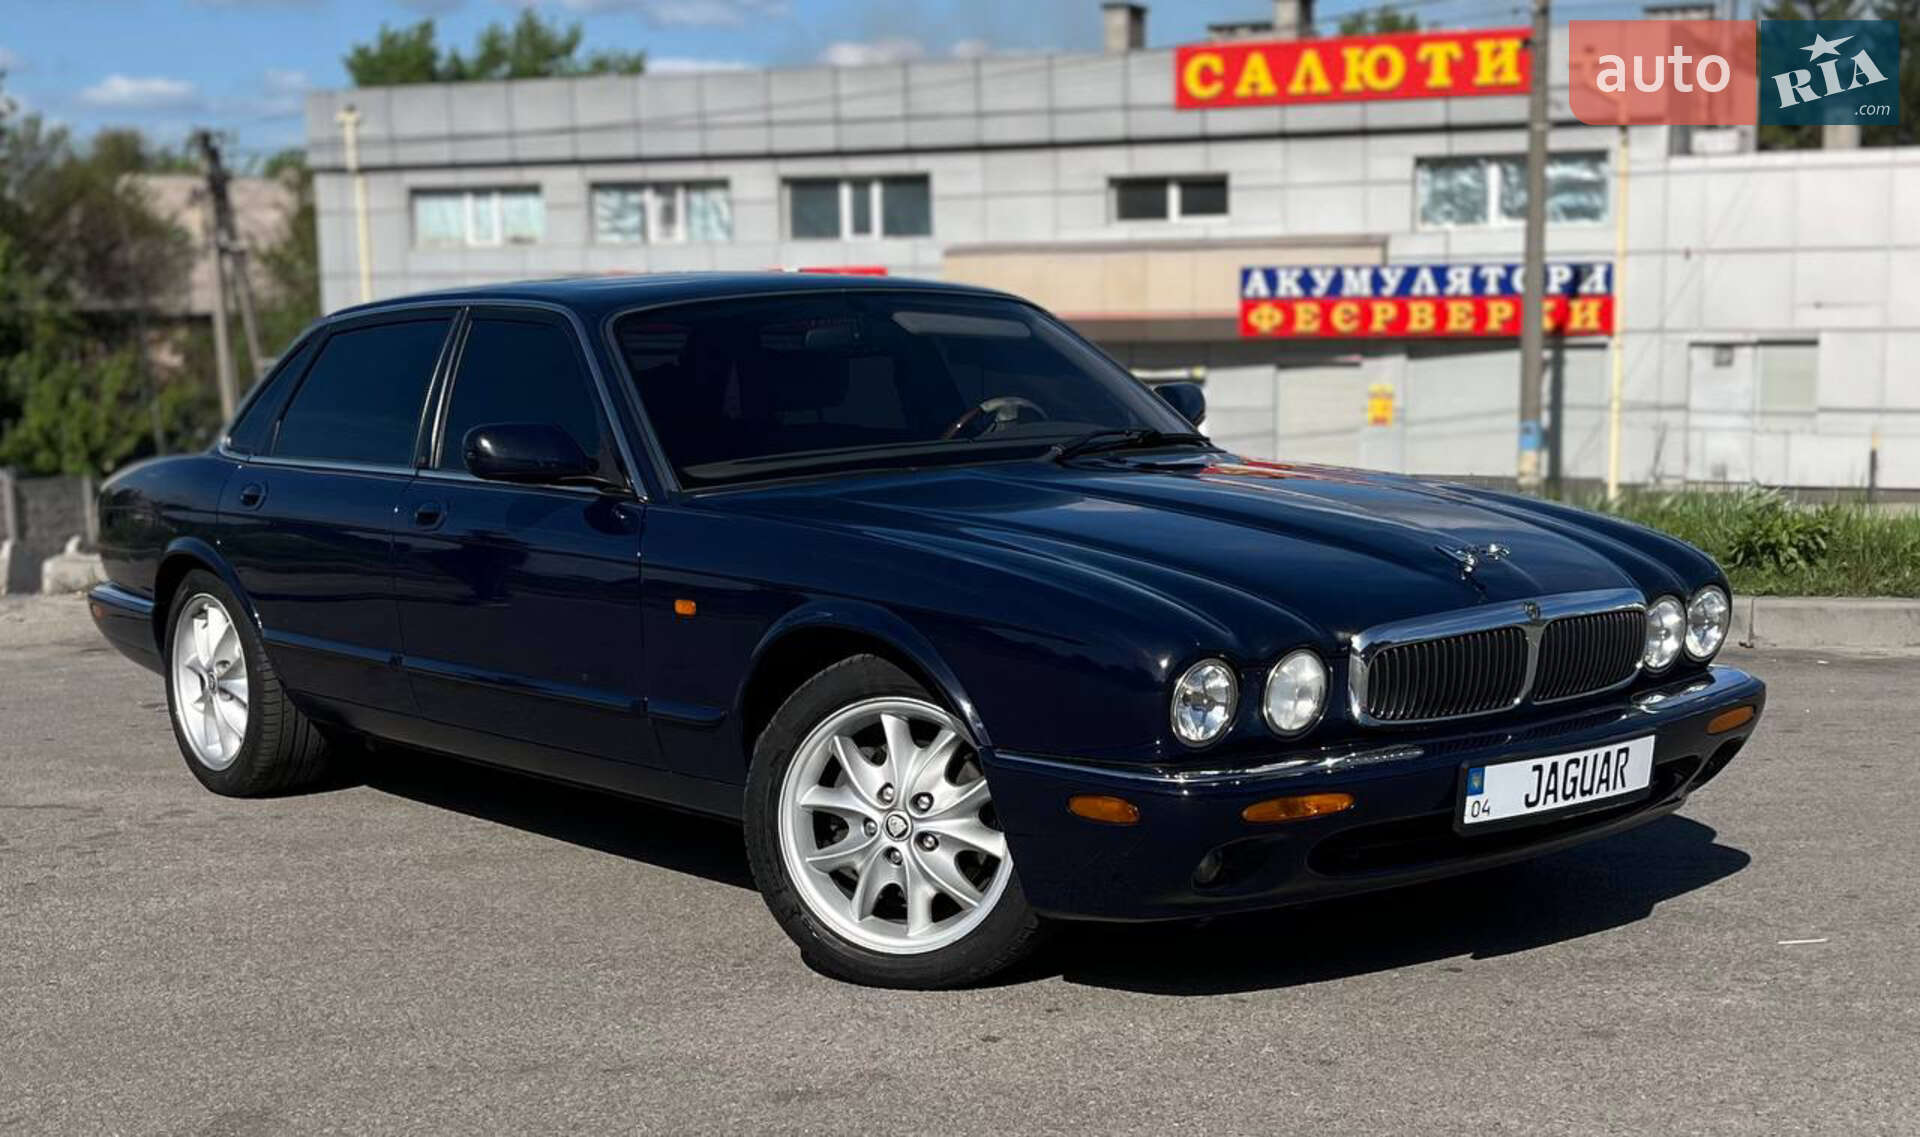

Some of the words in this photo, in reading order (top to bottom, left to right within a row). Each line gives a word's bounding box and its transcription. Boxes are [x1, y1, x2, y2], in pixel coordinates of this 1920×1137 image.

[1182, 38, 1524, 100] САЛЮТИ
[1470, 798, 1491, 818] 04
[1524, 746, 1631, 809] JAGUAR
